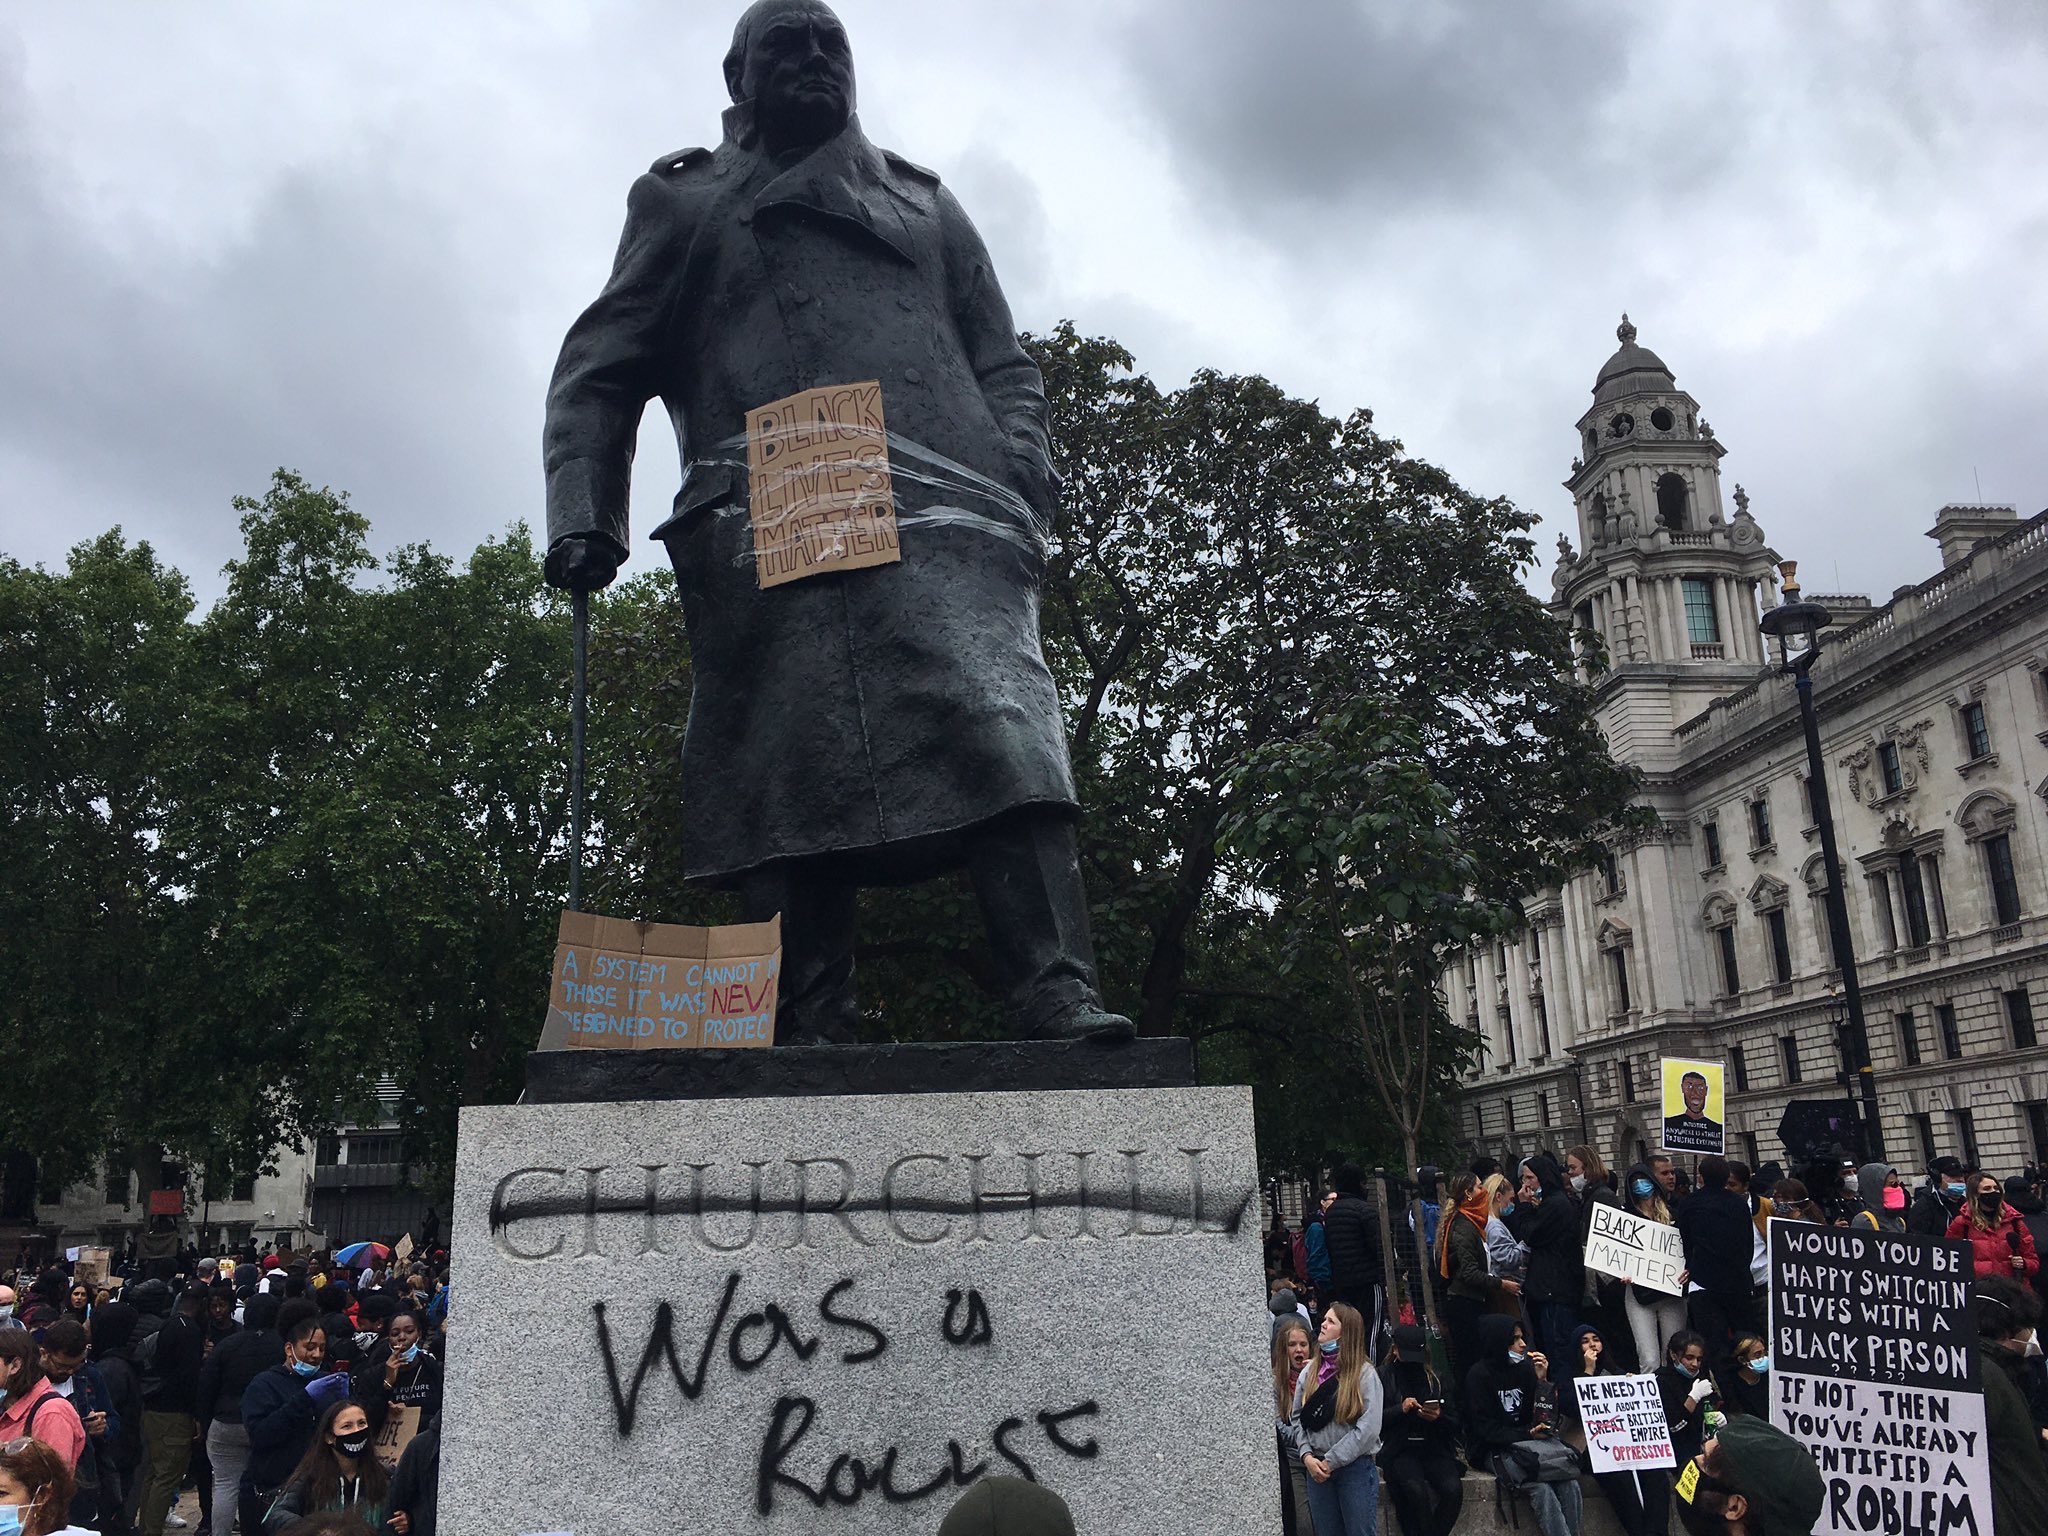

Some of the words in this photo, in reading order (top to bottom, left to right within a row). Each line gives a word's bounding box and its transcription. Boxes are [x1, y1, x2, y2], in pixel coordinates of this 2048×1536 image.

[756, 385, 884, 466] BLACK
[758, 444, 890, 522] LIVES
[757, 499, 899, 577] MATTER
[561, 950, 580, 979] A
[594, 955, 667, 983] SYSTEM
[686, 960, 760, 986] CANNOT
[561, 980, 617, 1007] THOSE
[628, 988, 650, 1011] IT
[659, 991, 707, 1016] WAS
[660, 1017, 688, 1040] TO
[1673, 1135, 1694, 1144] JUSTICE
[490, 1147, 1236, 1260] CHURCHILL
[1594, 1209, 1646, 1247] BLACK
[1650, 1228, 1684, 1259] LIVES
[1785, 1230, 1865, 1260] WOULD
[1875, 1240, 1921, 1266] YOU
[1932, 1246, 1960, 1273] BE
[1591, 1242, 1682, 1290] MATTER.
[1782, 1262, 1853, 1293] HAPPY
[1860, 1269, 1972, 1310] SWITCHIN'
[1782, 1291, 1852, 1325] LIVES
[1861, 1302, 1921, 1332] WITH
[1932, 1312, 1951, 1333] A
[594, 1273, 889, 1437] Was
[942, 1288, 993, 1347] a
[1781, 1327, 1859, 1364] BLACK
[1867, 1334, 1967, 1379] PERSON
[1577, 1384, 1600, 1401] WE
[1601, 1382, 1636, 1399] NEED
[1637, 1380, 1657, 1397] TO
[1582, 1403, 1611, 1416] TALK
[1615, 1400, 1641, 1413] ABOUT
[1644, 1399, 1662, 1409] THE
[1778, 1376, 1806, 1404] IF
[1814, 1380, 1868, 1417] NOT,
[1878, 1391, 1950, 1424] THEN
[1627, 1412, 1666, 1427] BRITISH
[1631, 1426, 1667, 1442] EMPIRE
[1783, 1409, 1862, 1444] YOU'VE
[1872, 1421, 1977, 1457] ALREADY
[1612, 1443, 1673, 1461] OPPRESSIVE
[1943, 1460, 1968, 1487] A
